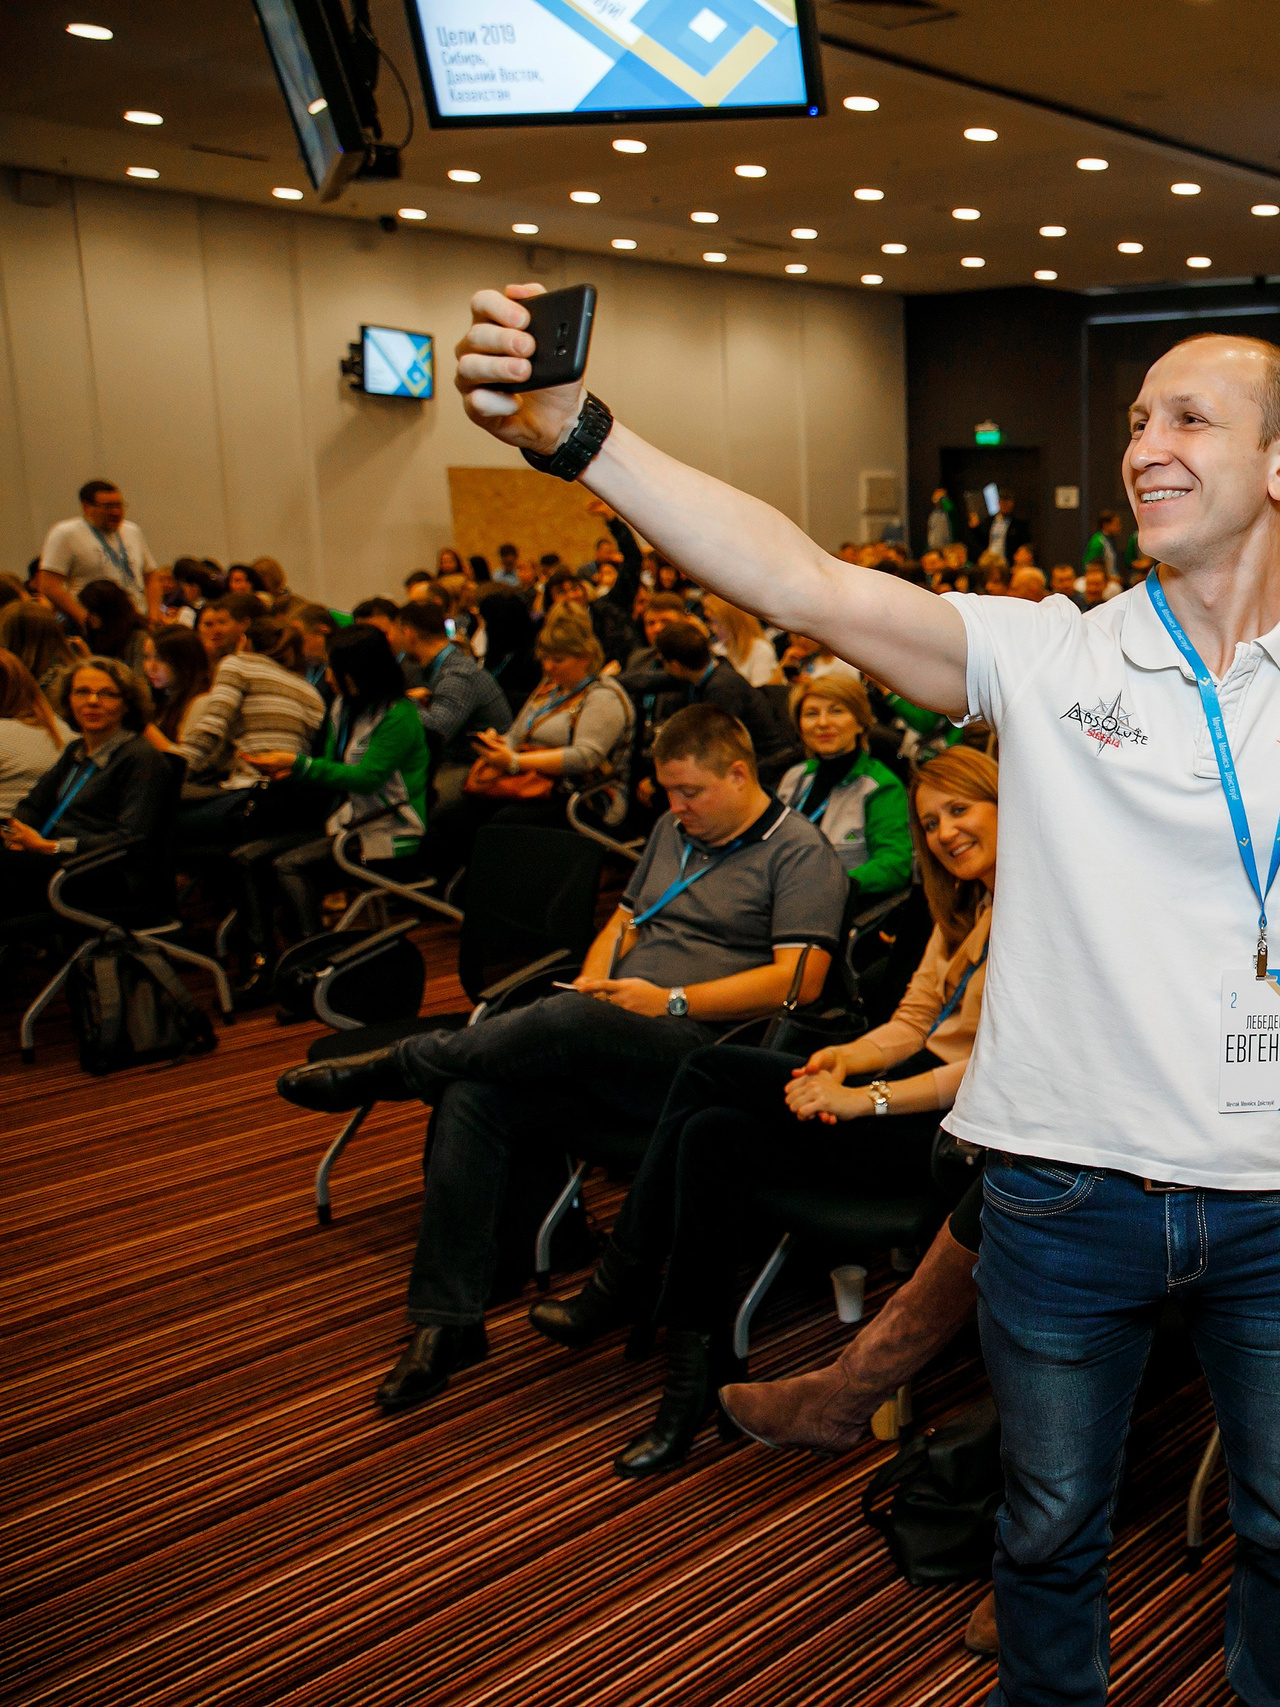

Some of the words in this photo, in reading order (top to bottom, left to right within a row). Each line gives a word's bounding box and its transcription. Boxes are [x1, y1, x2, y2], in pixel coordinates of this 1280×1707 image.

[436, 25, 478, 48] Цели
[480, 23, 516, 45] 2019
[442, 50, 488, 67] Сибирь,
[1230, 992, 1237, 1008] 2
